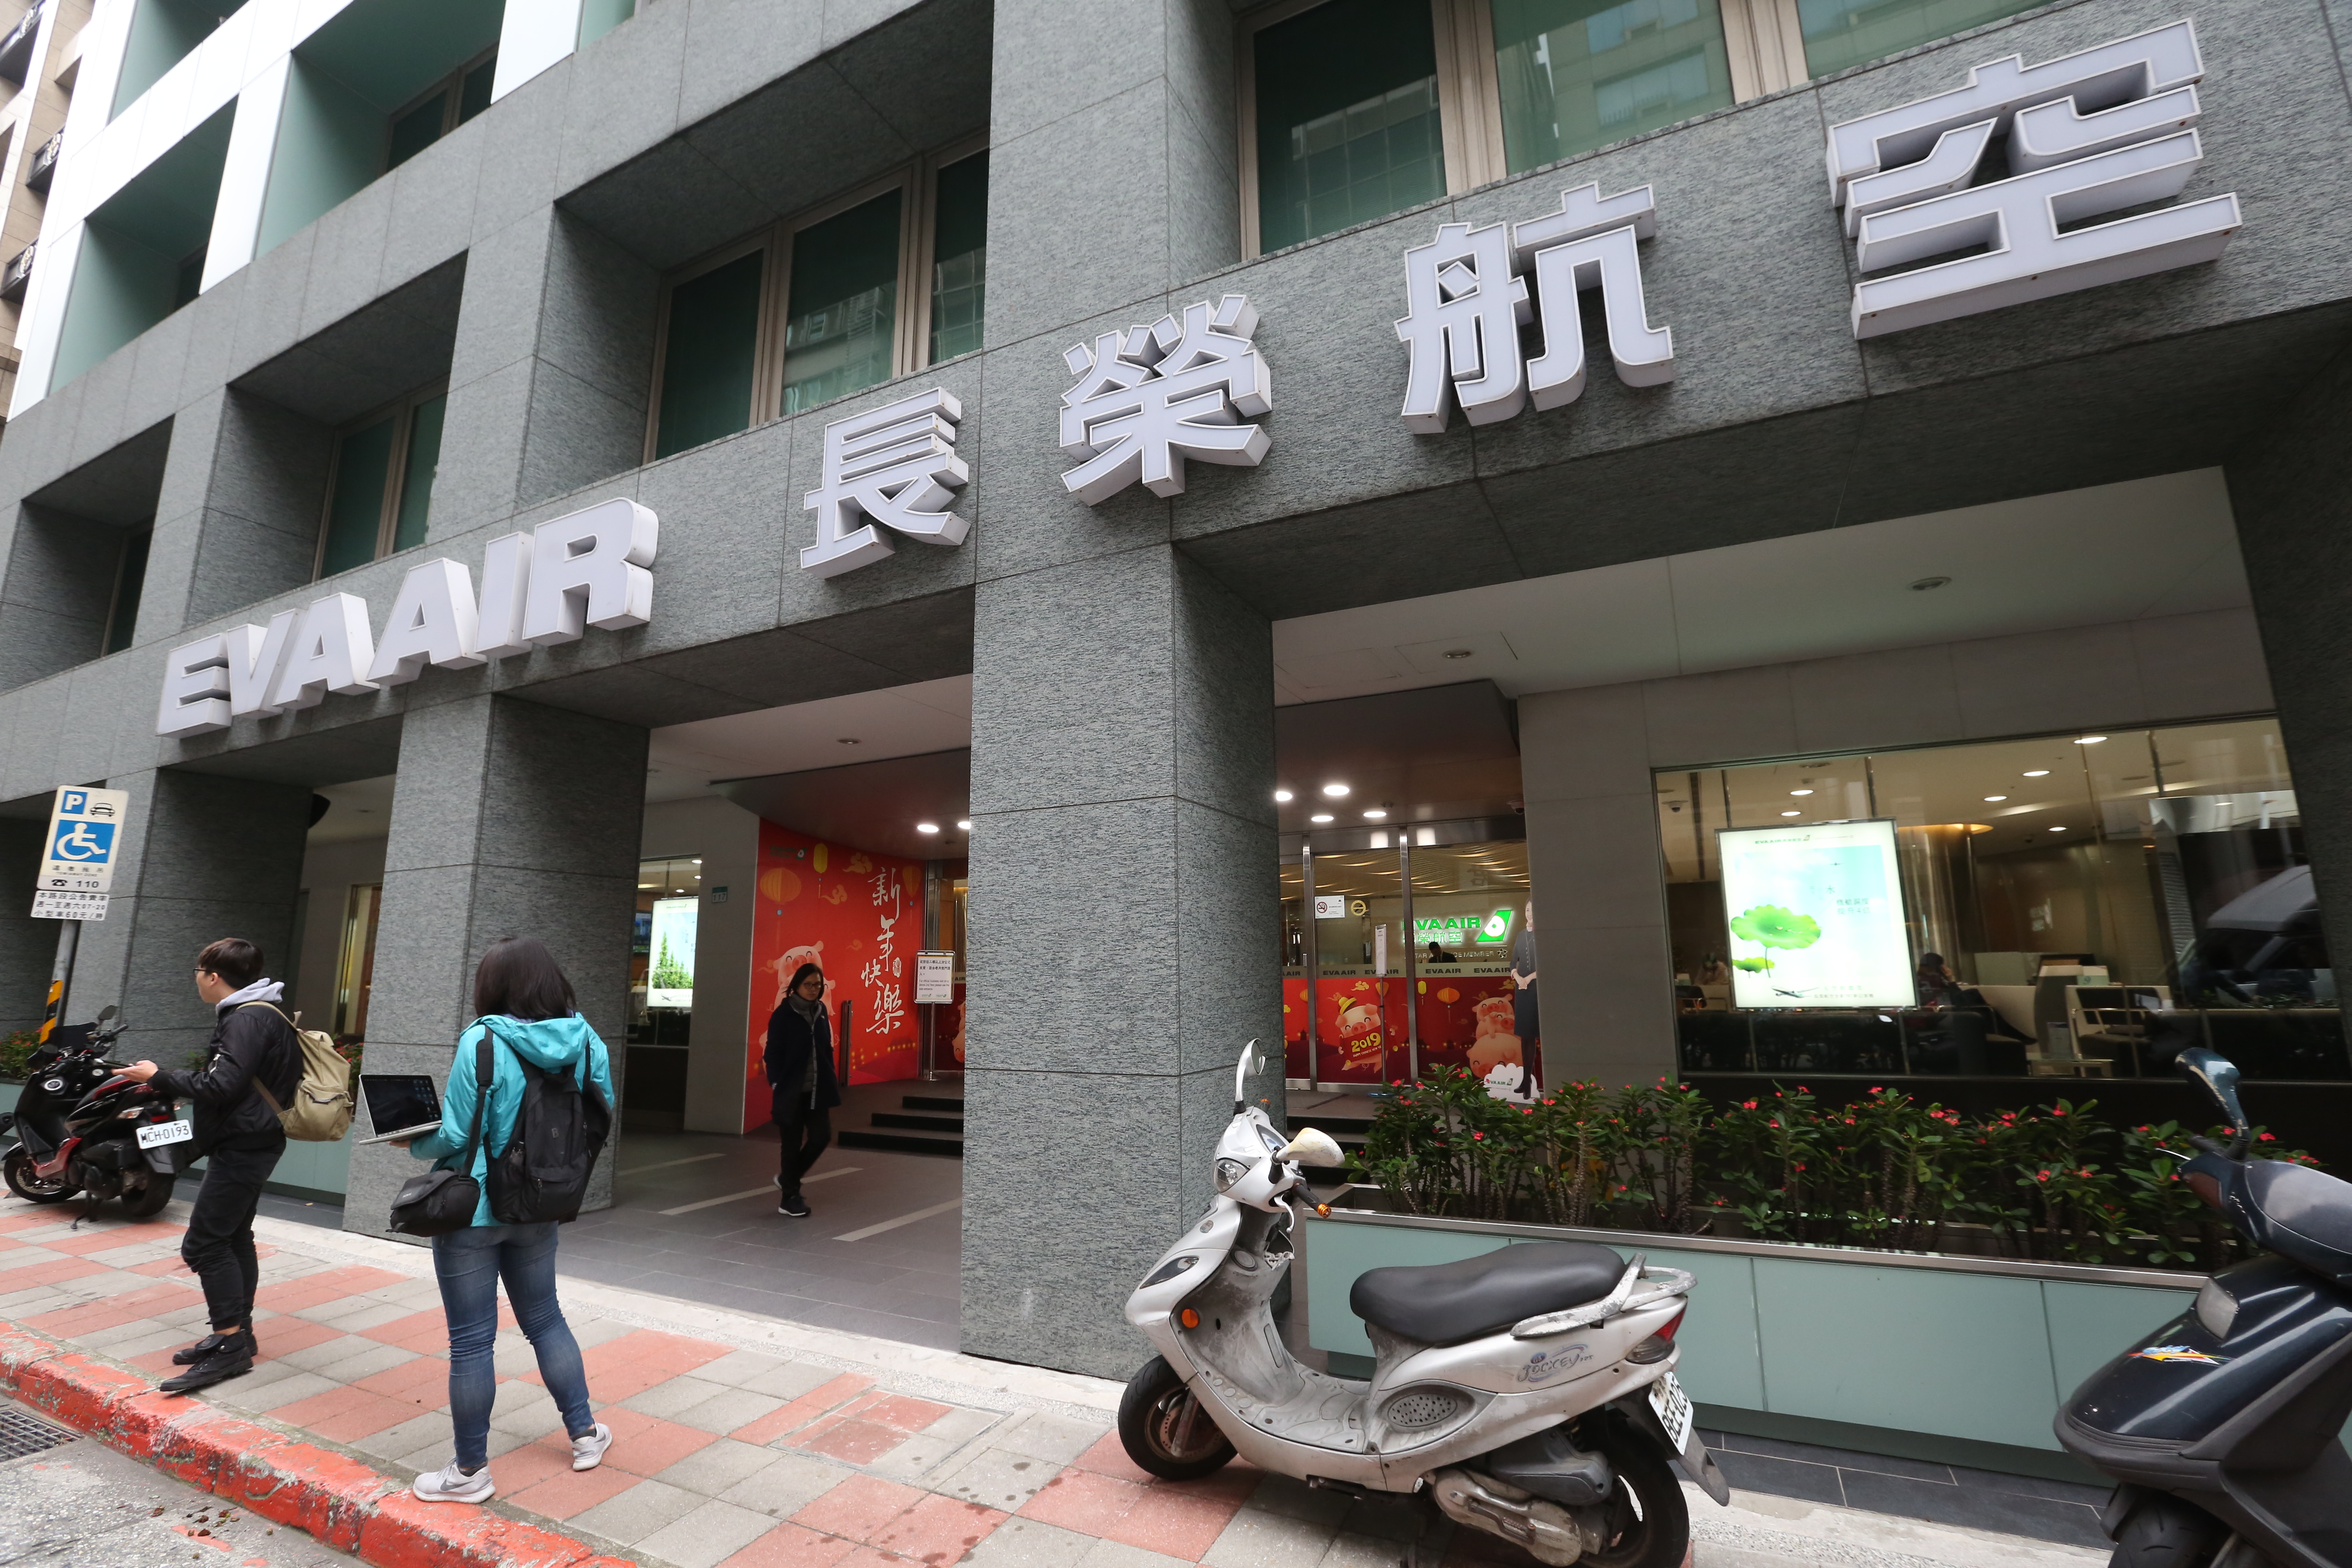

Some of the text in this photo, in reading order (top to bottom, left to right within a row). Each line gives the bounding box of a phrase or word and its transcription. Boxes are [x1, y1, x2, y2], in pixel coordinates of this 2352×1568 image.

[800, 18, 2243, 578] 長榮航空
[1402, 917, 1481, 931] VAAIR
[860, 867, 904, 1034] 新年快樂
[1351, 1032, 1381, 1053] 2019
[140, 1125, 189, 1144] MCH-0193
[1662, 1375, 1688, 1445] BEE-025
